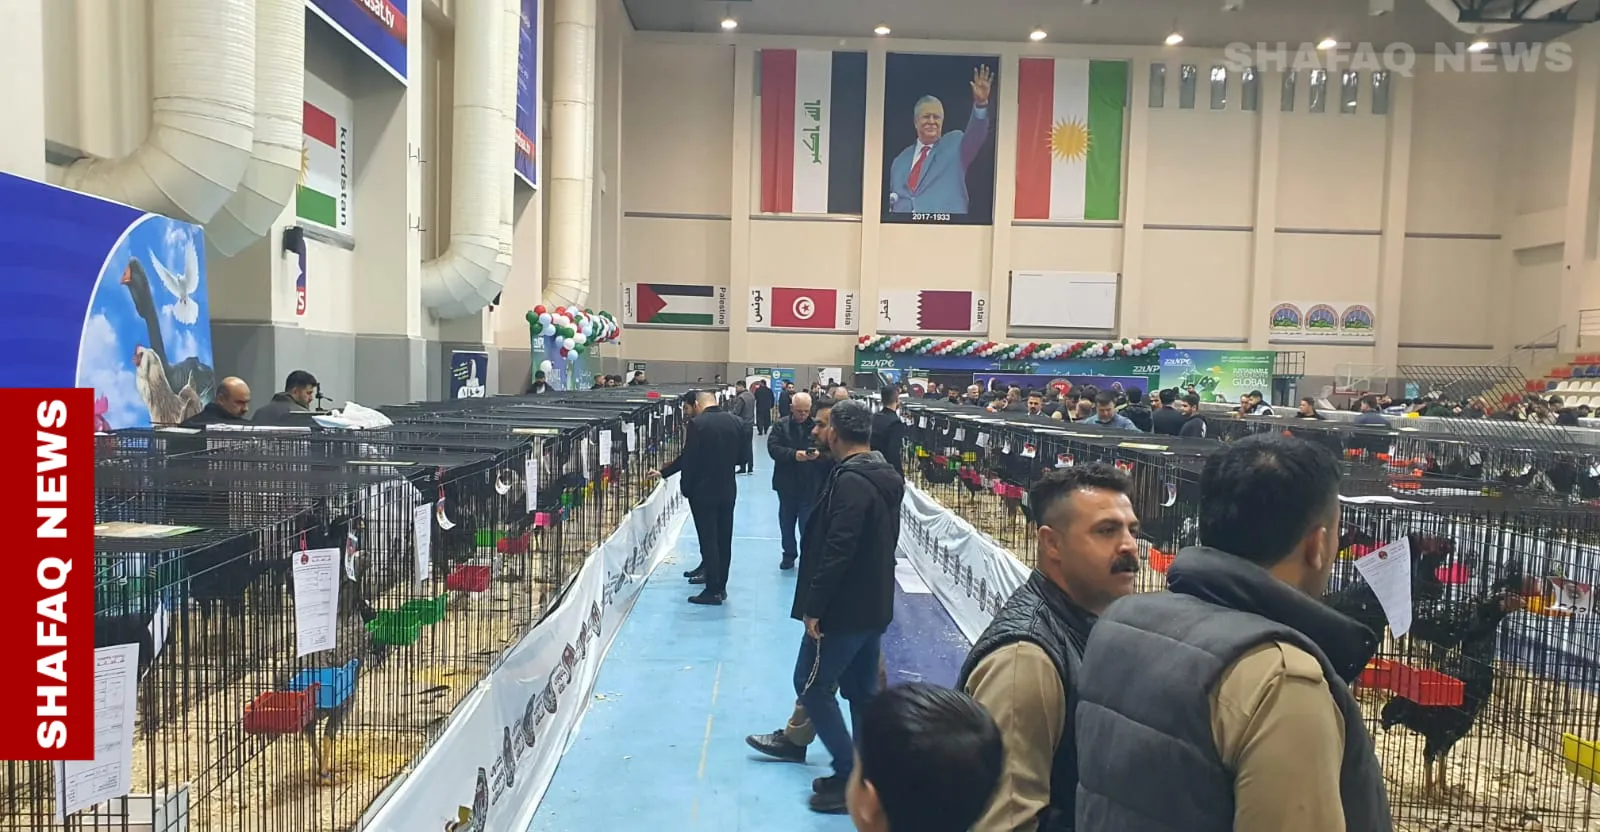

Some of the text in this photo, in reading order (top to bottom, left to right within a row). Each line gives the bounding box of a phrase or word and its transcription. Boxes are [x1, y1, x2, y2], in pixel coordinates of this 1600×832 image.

[911, 213, 950, 221] 2017-1933
[719, 287, 727, 325] Palestine
[751, 290, 764, 323] تونس
[844, 293, 853, 326] Tunisia
[880, 299, 891, 323] قطر
[977, 299, 985, 323] Qatar
[1232, 378, 1269, 388] GLOBAL
